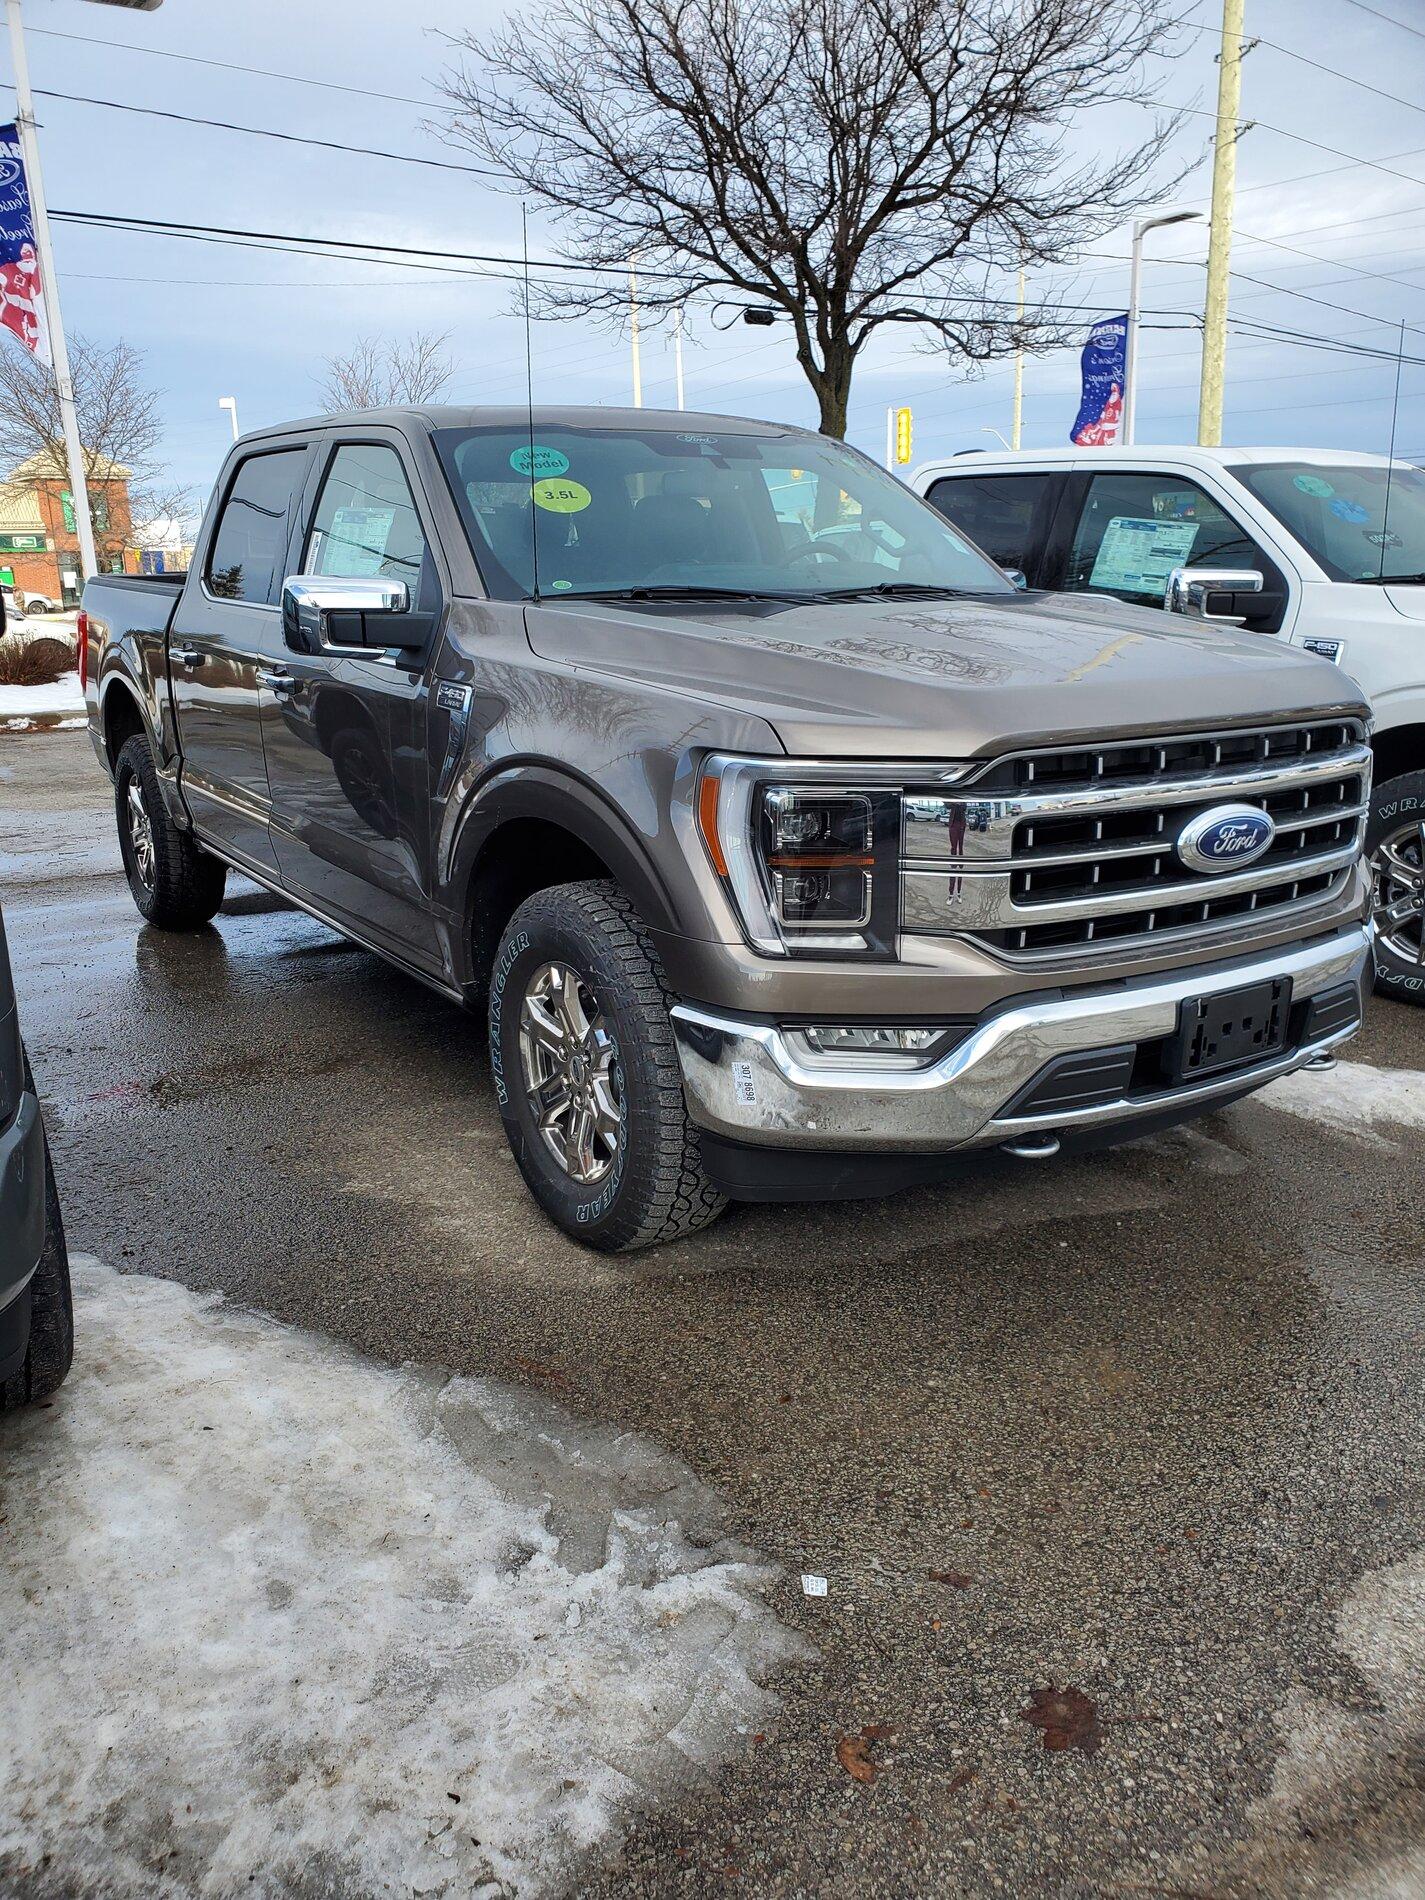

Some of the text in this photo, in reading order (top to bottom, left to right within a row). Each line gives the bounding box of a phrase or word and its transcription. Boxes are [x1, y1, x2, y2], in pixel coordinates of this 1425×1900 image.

[521, 452, 551, 460] New
[519, 460, 564, 470] Model
[544, 491, 578, 500] 3.5L
[1304, 641, 1338, 651] F-150
[1213, 823, 1258, 854] Ford
[491, 931, 530, 1106] WRANGLER
[741, 1064, 756, 1101] 307 8698
